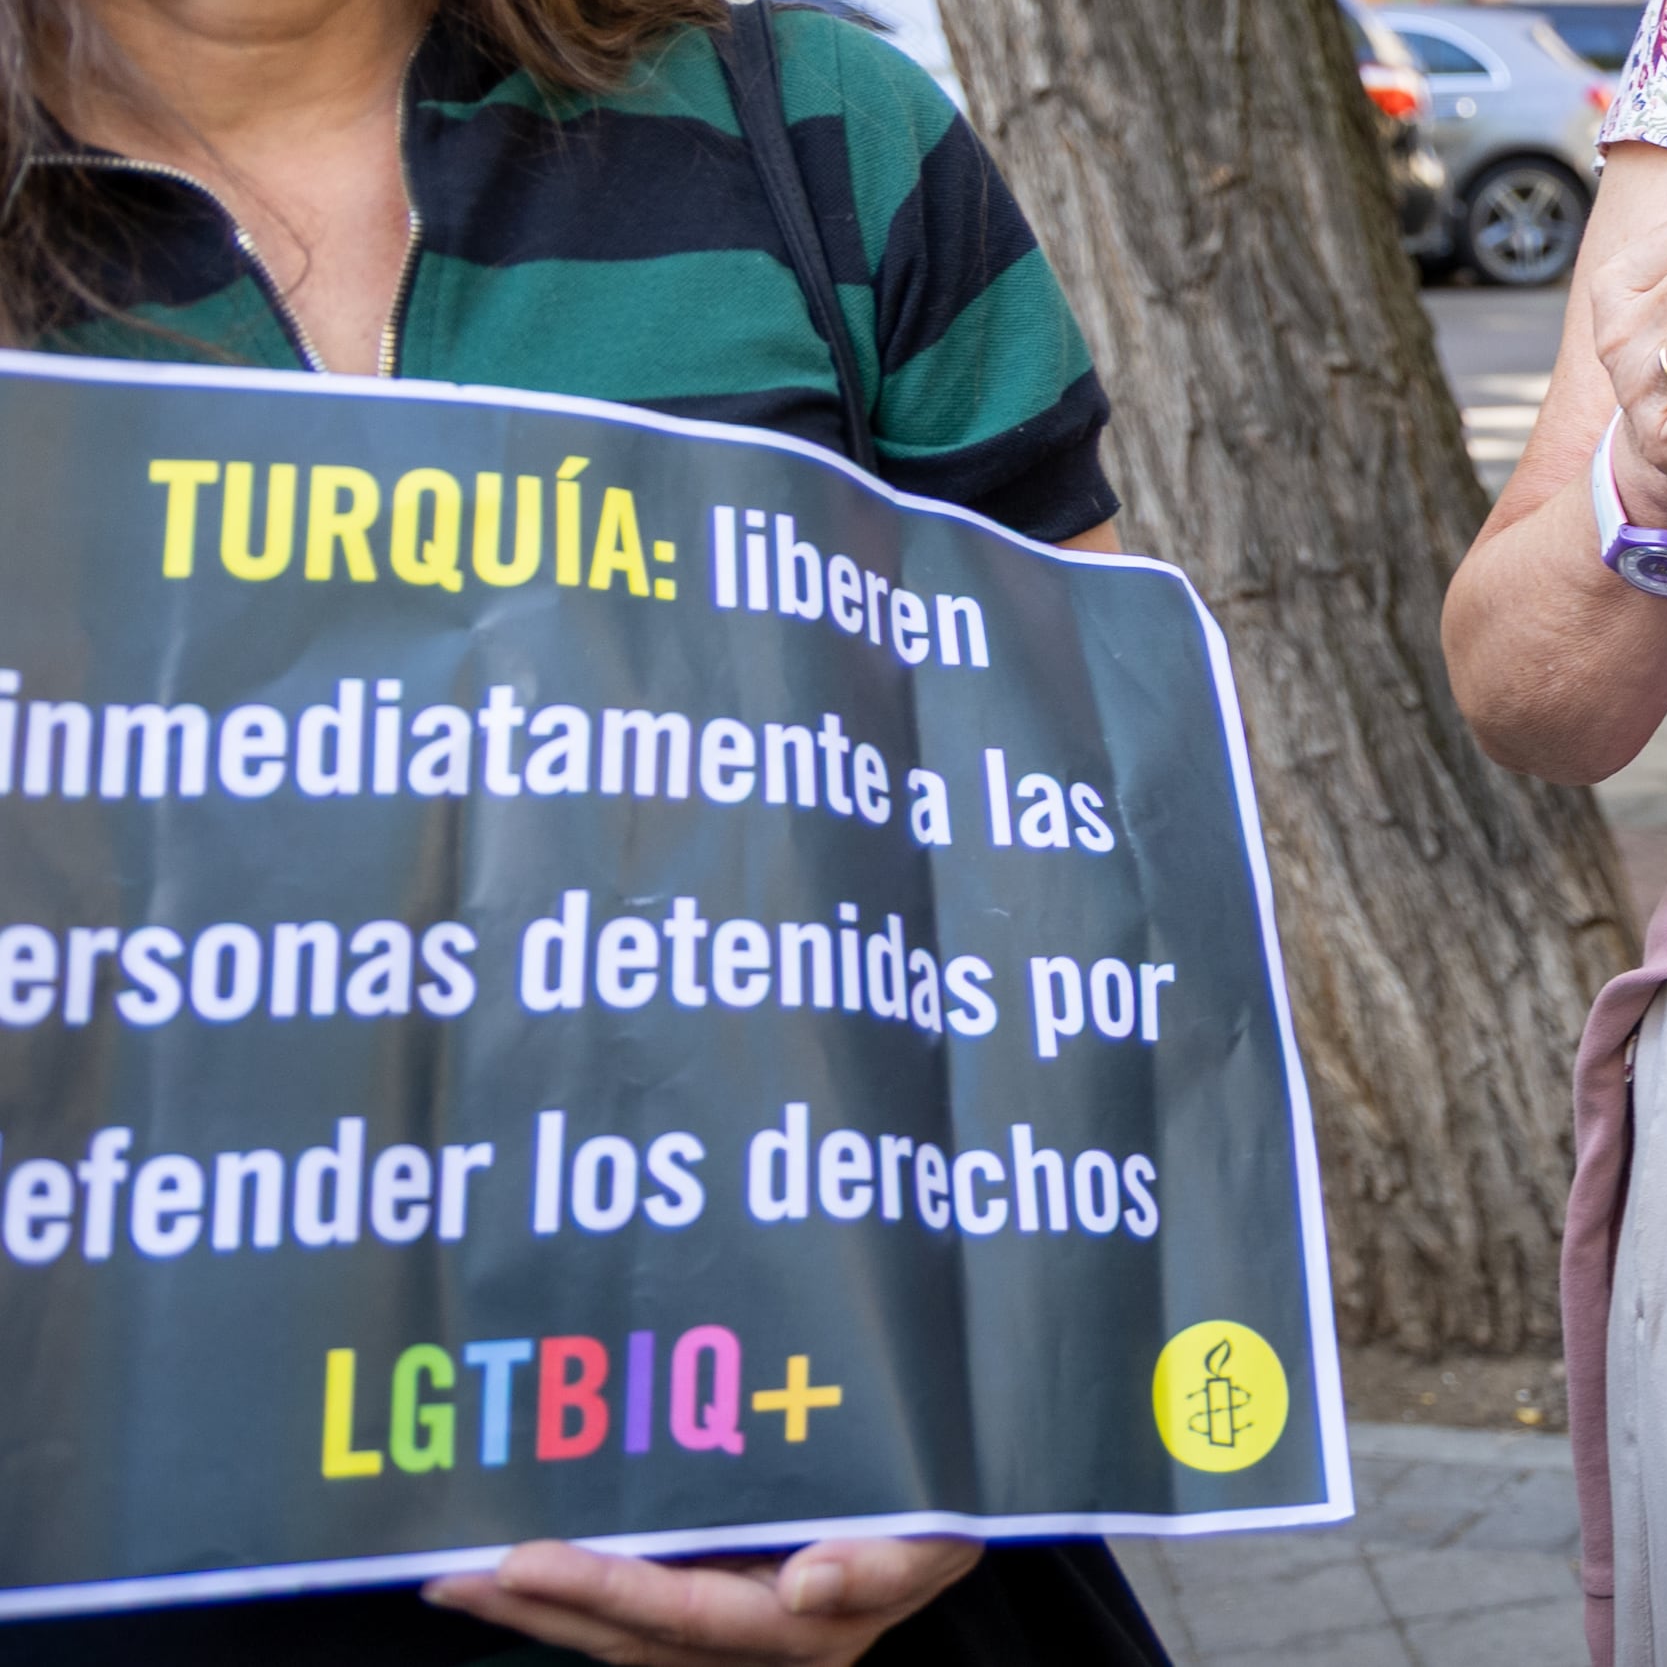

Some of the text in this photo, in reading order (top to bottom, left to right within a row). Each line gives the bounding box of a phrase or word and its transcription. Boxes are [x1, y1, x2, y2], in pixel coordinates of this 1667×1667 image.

[149, 455, 991, 669] TURQUÍA: liberen
[0, 671, 1116, 854] inmediatamente a las
[0, 888, 1176, 1062] ersonas detenidas por
[1, 1101, 1159, 1265] efender los derechos
[323, 1326, 841, 1477] LGTBIQ+
